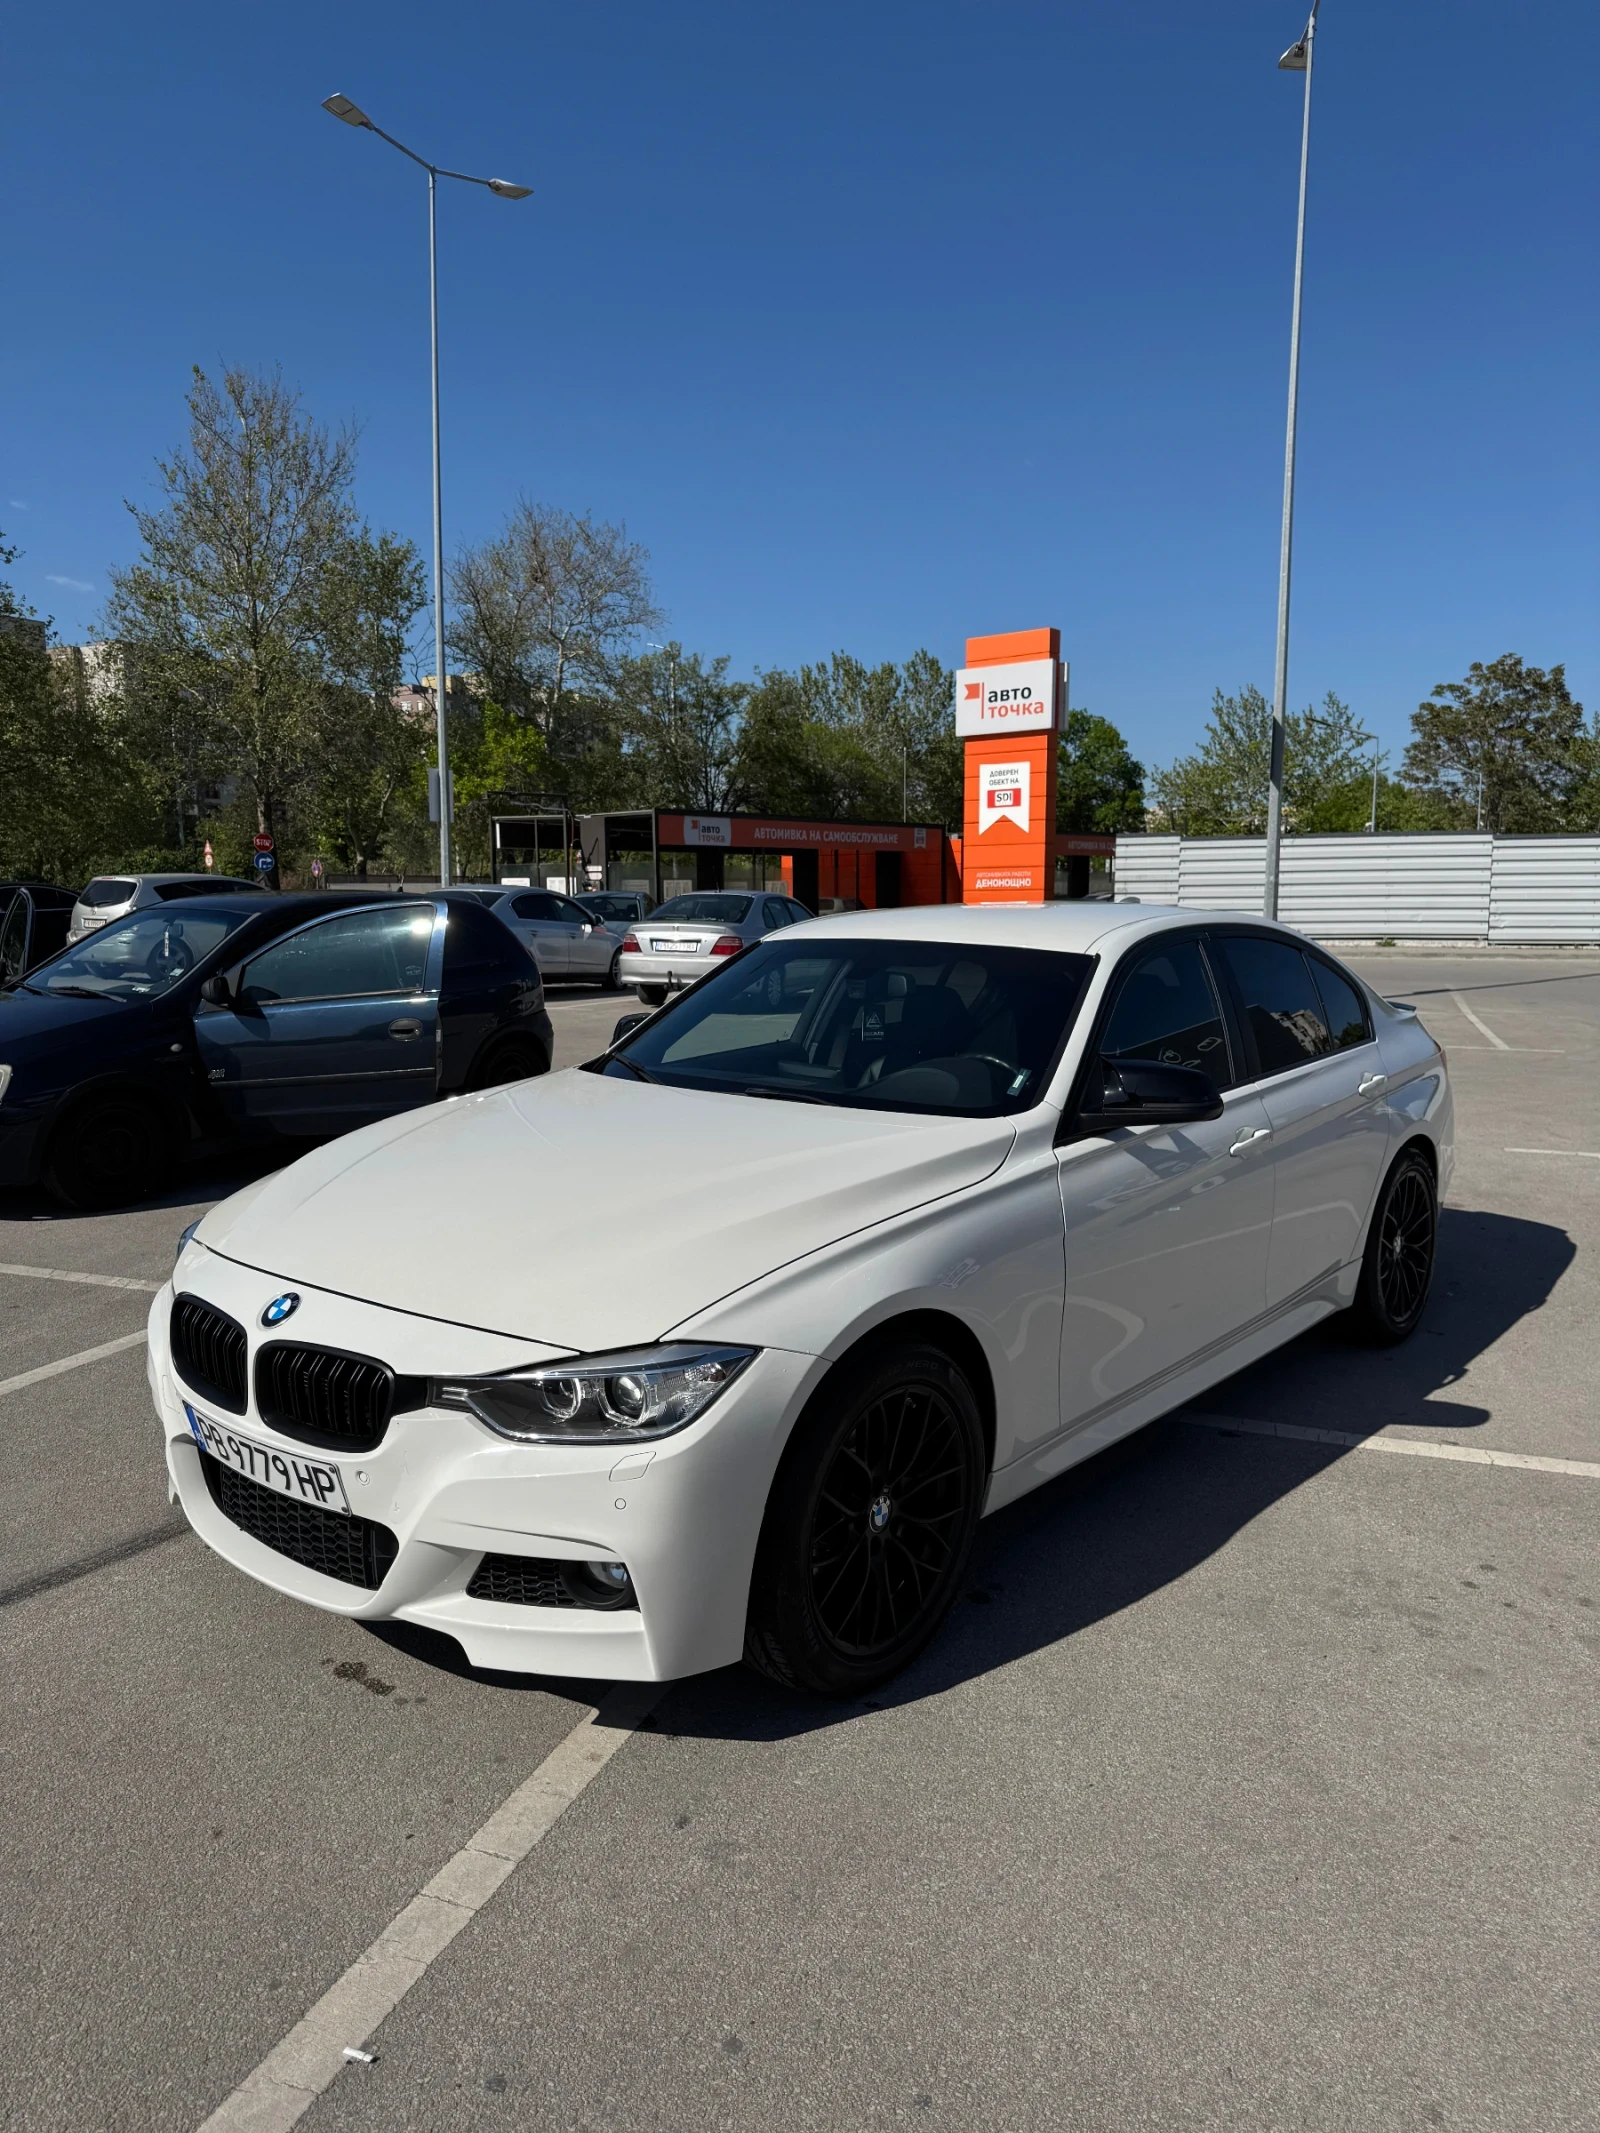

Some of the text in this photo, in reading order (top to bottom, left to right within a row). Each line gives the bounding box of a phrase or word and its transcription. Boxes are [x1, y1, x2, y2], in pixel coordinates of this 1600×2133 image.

[988, 687, 1032, 703] авто
[988, 701, 1044, 719] точка
[989, 769, 1019, 778] ДОВЕРЕН
[988, 777, 1019, 786] ОБЕКТ НА
[996, 792, 1012, 802] SDI
[701, 825, 721, 834] авто
[701, 834, 726, 843] точка
[754, 827, 807, 841] АВТОМИВКА
[809, 830, 821, 841] НА
[823, 831, 899, 844] САМООБСЛУЖВАНЕ
[256, 838, 272, 847] STOP
[976, 878, 1031, 889] ДЕНОНОЩНО
